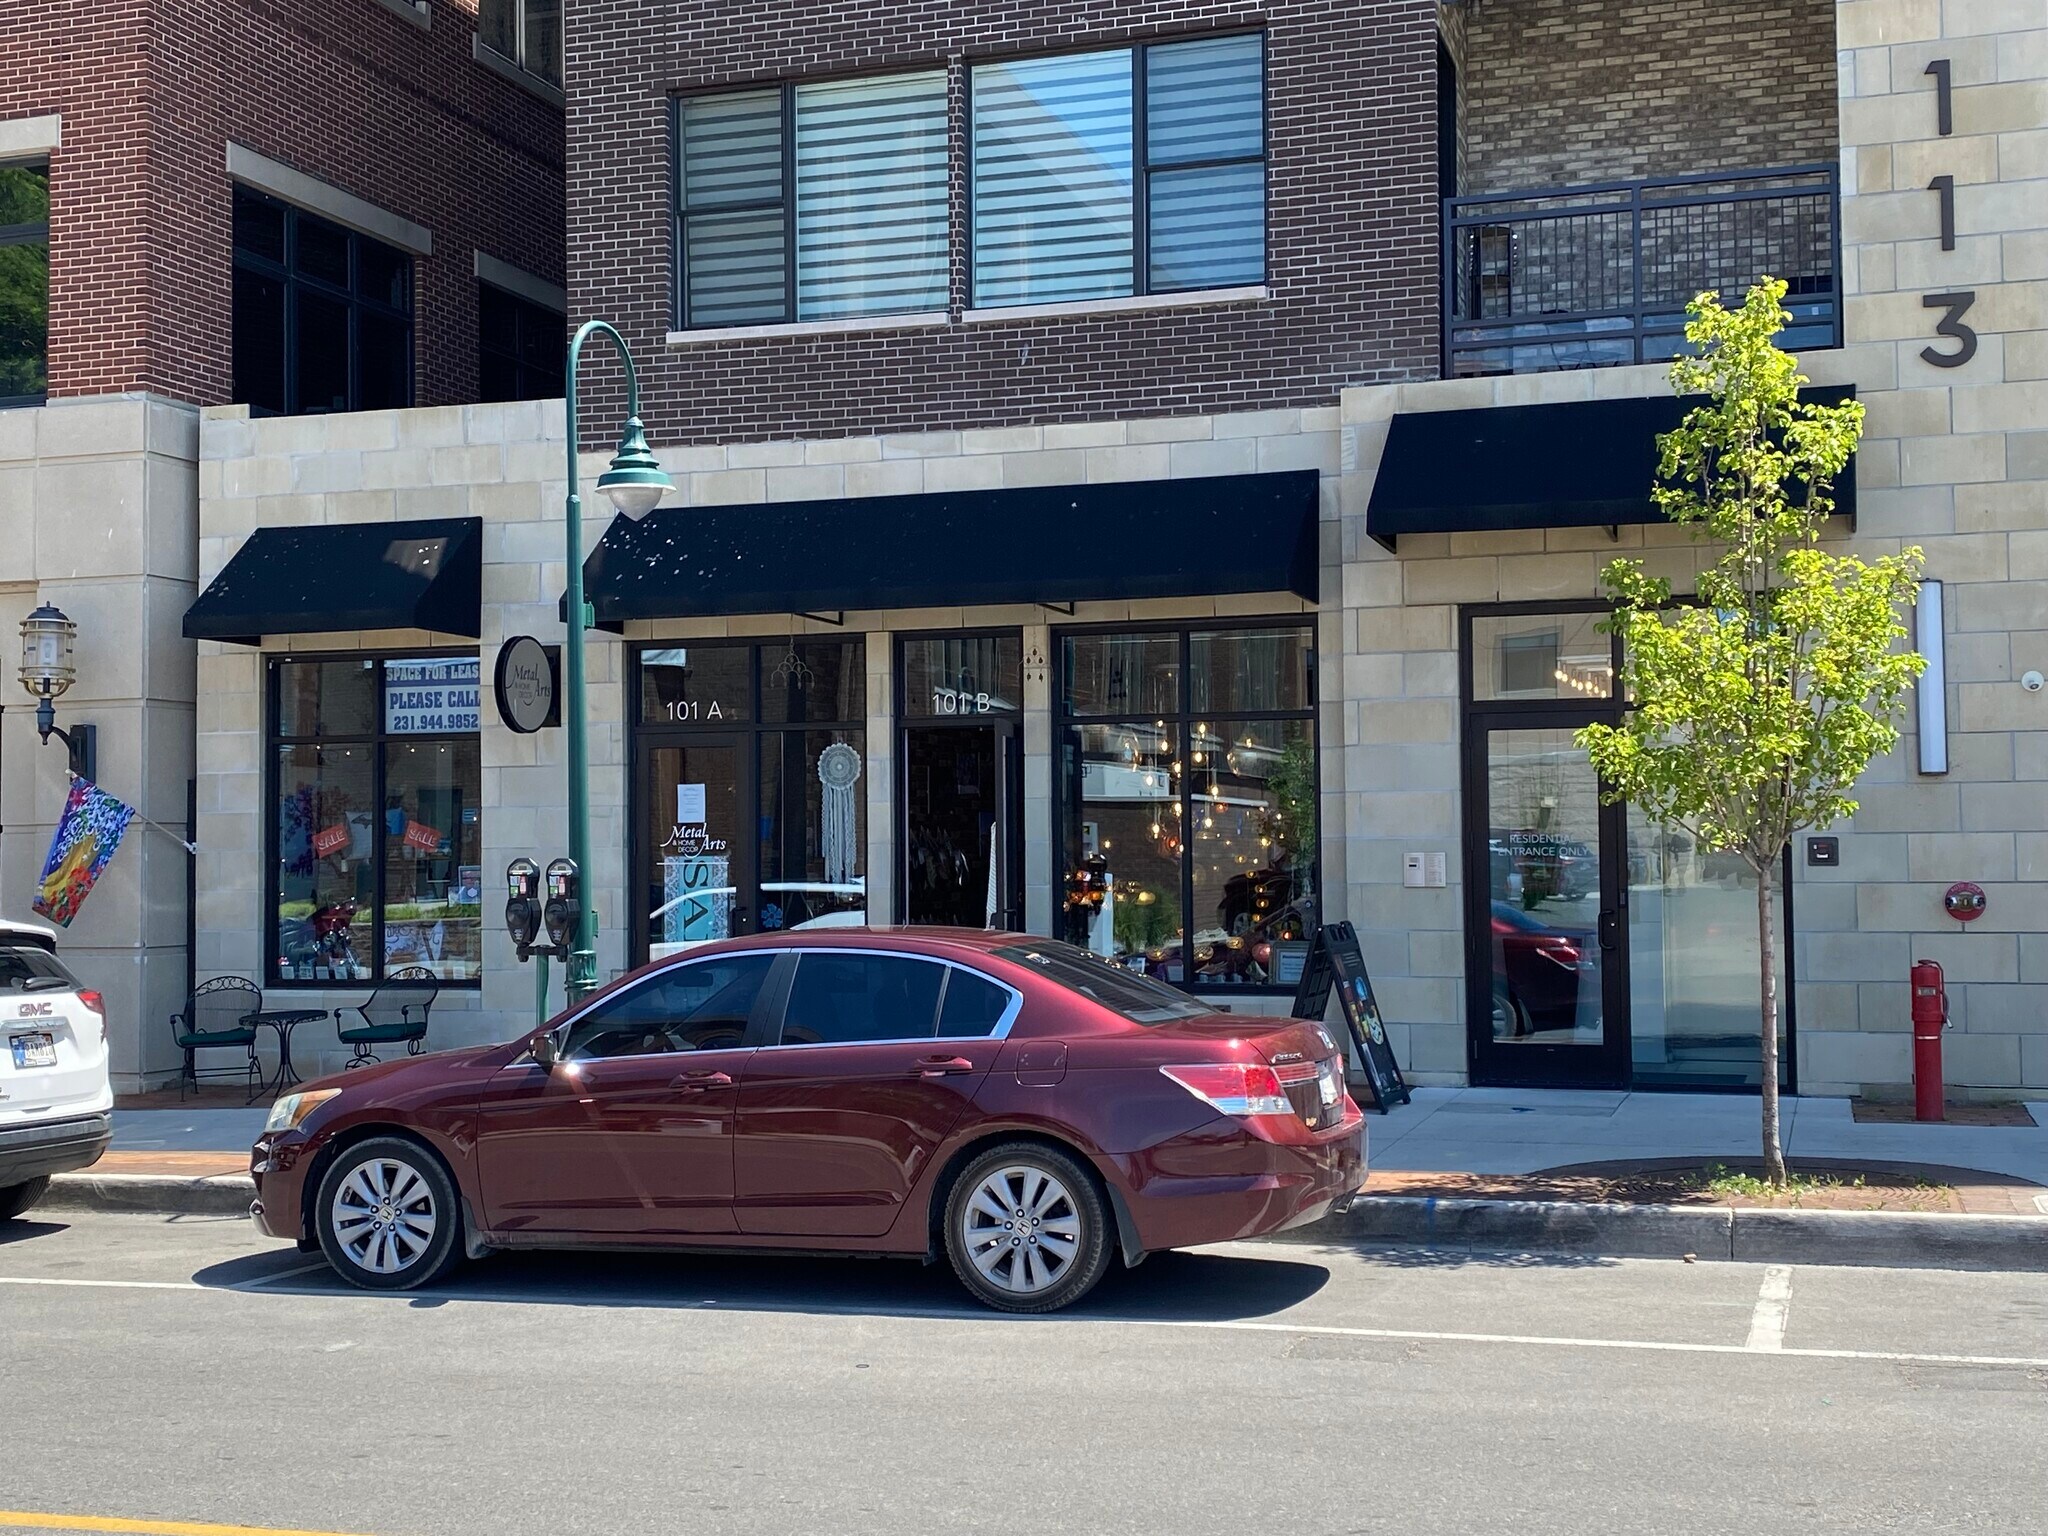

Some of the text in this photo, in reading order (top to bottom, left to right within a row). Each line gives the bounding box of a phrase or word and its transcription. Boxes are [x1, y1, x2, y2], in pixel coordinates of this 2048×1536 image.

[386, 665, 480, 681] SPACE FOR LEAS
[389, 690, 481, 710] PLEASE CALL
[666, 700, 723, 720] 101 A
[932, 692, 990, 713] 101 B
[393, 713, 479, 731] 231.944.9852
[317, 829, 346, 850] SALE
[408, 828, 435, 848] SALE
[1509, 834, 1578, 844] RESIDENTIAL
[1498, 846, 1589, 856] ENTRANCE ONLY
[683, 860, 709, 941] SA
[18, 1002, 53, 1017] GMC
